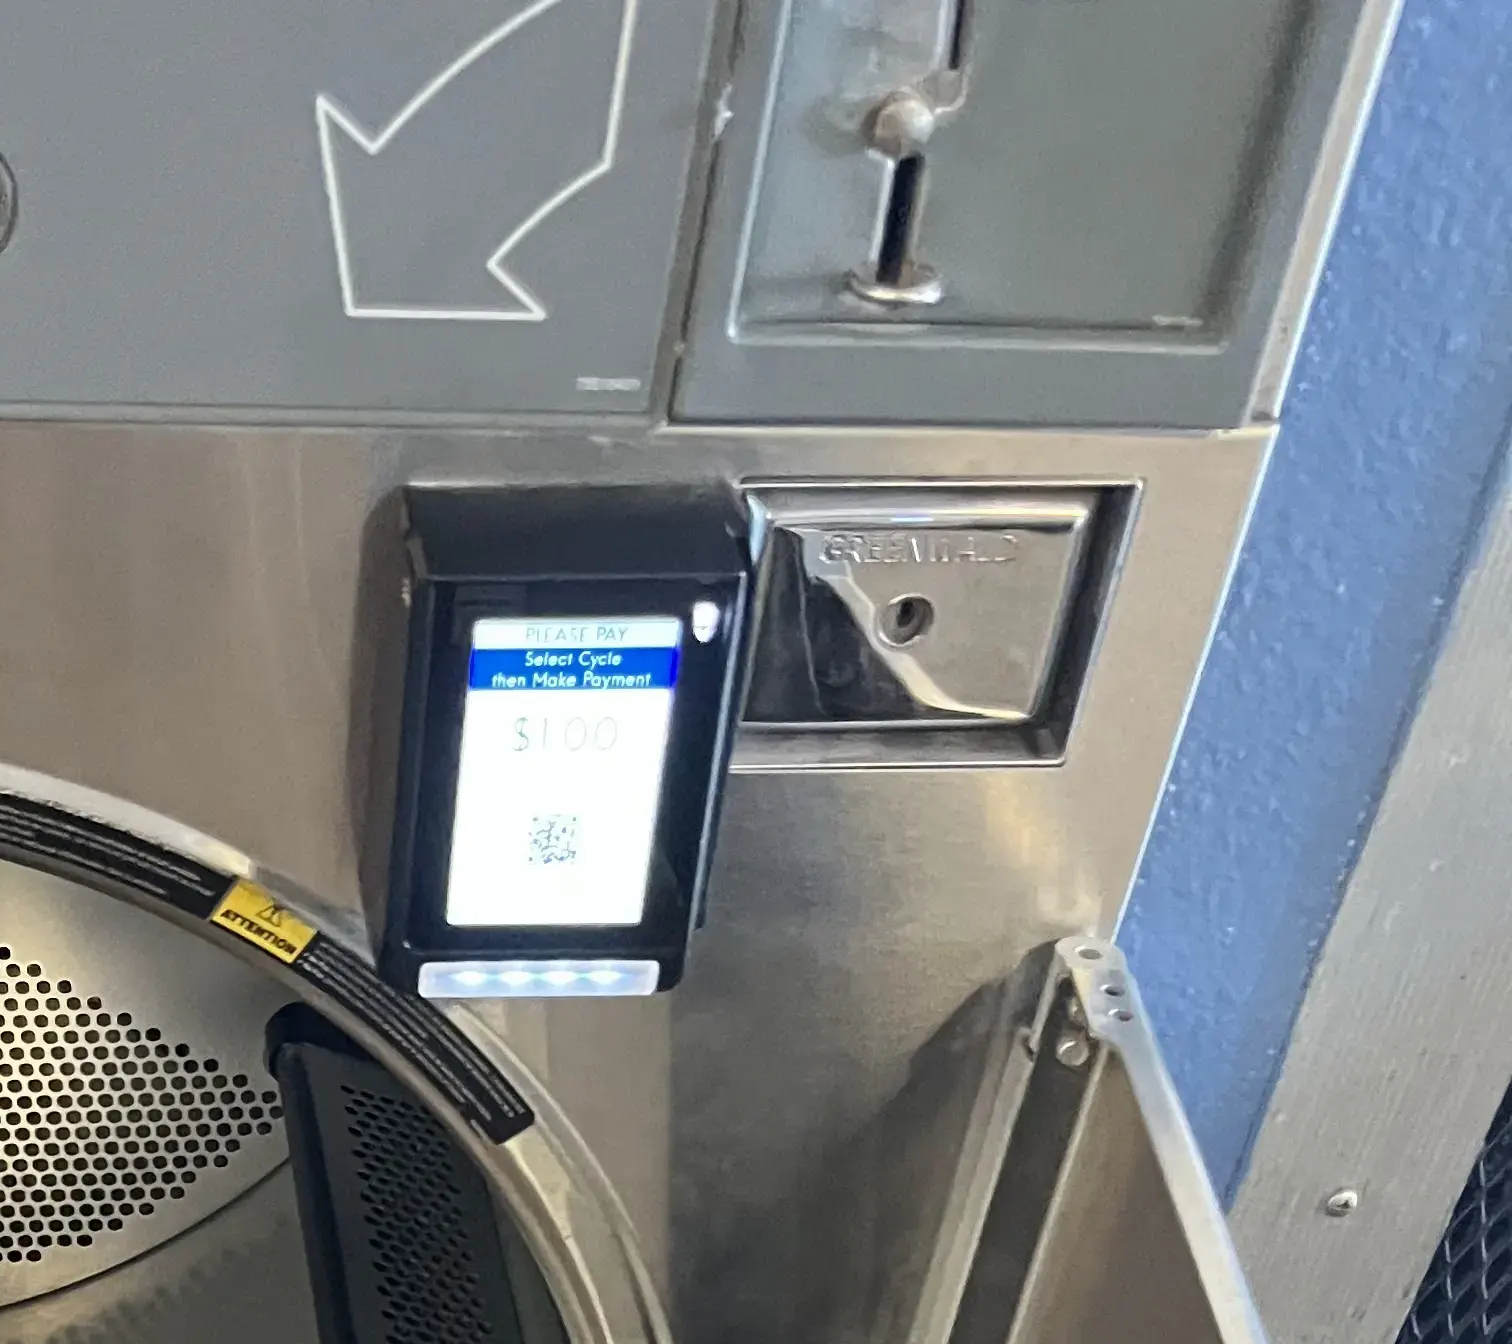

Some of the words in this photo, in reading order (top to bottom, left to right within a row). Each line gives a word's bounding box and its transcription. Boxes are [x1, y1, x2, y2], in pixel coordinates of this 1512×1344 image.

[596, 626, 629, 642] PAY
[524, 651, 573, 667] Select
[578, 650, 623, 669] Cycle
[491, 671, 526, 688] then
[532, 671, 577, 688] Make
[582, 671, 651, 690] Payment
